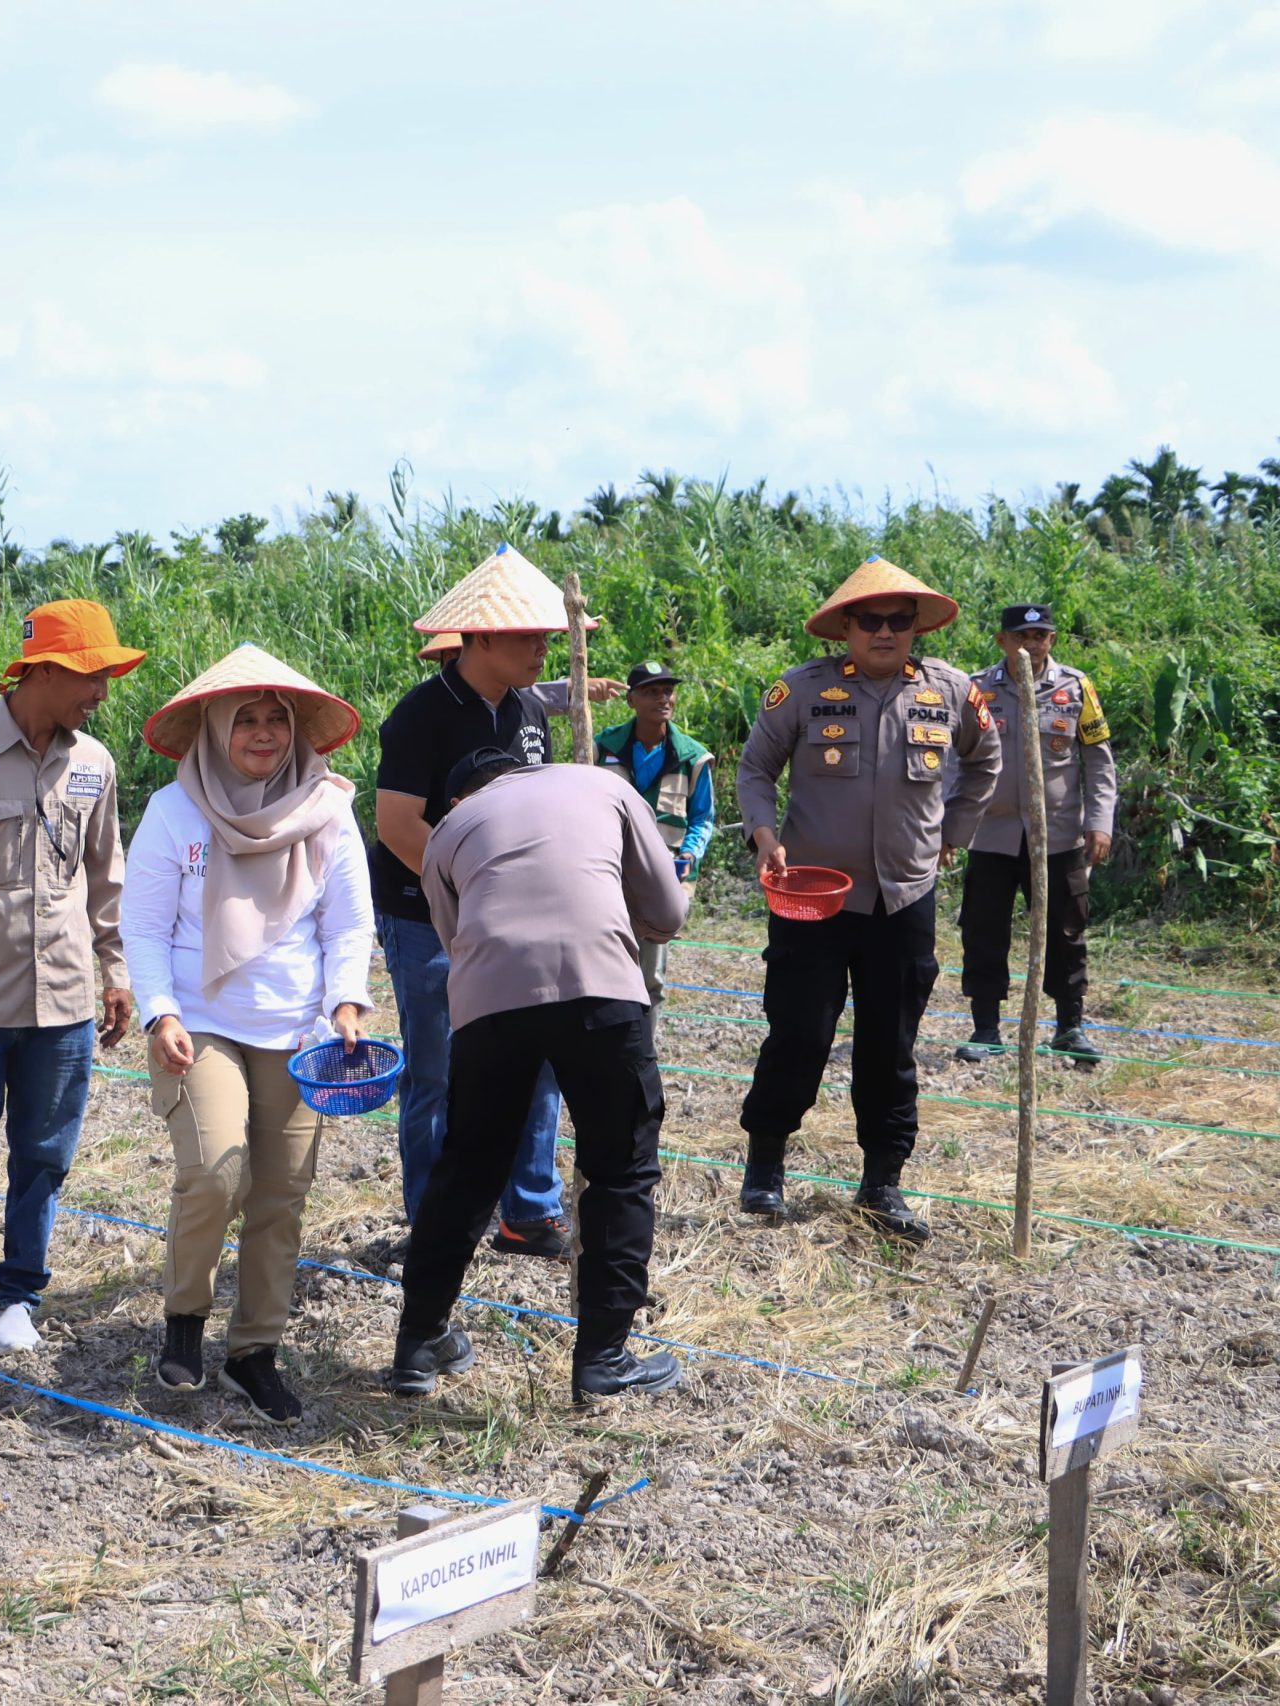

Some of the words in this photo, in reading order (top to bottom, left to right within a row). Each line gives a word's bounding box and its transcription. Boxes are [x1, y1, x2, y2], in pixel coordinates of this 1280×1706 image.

[811, 705, 856, 717] DELNI
[908, 707, 950, 723] POLRI
[1073, 1391, 1105, 1416] BUPATI
[1105, 1382, 1127, 1403] INHIL
[401, 1555, 475, 1601] KAPOLRES
[479, 1541, 518, 1570] INHIL
